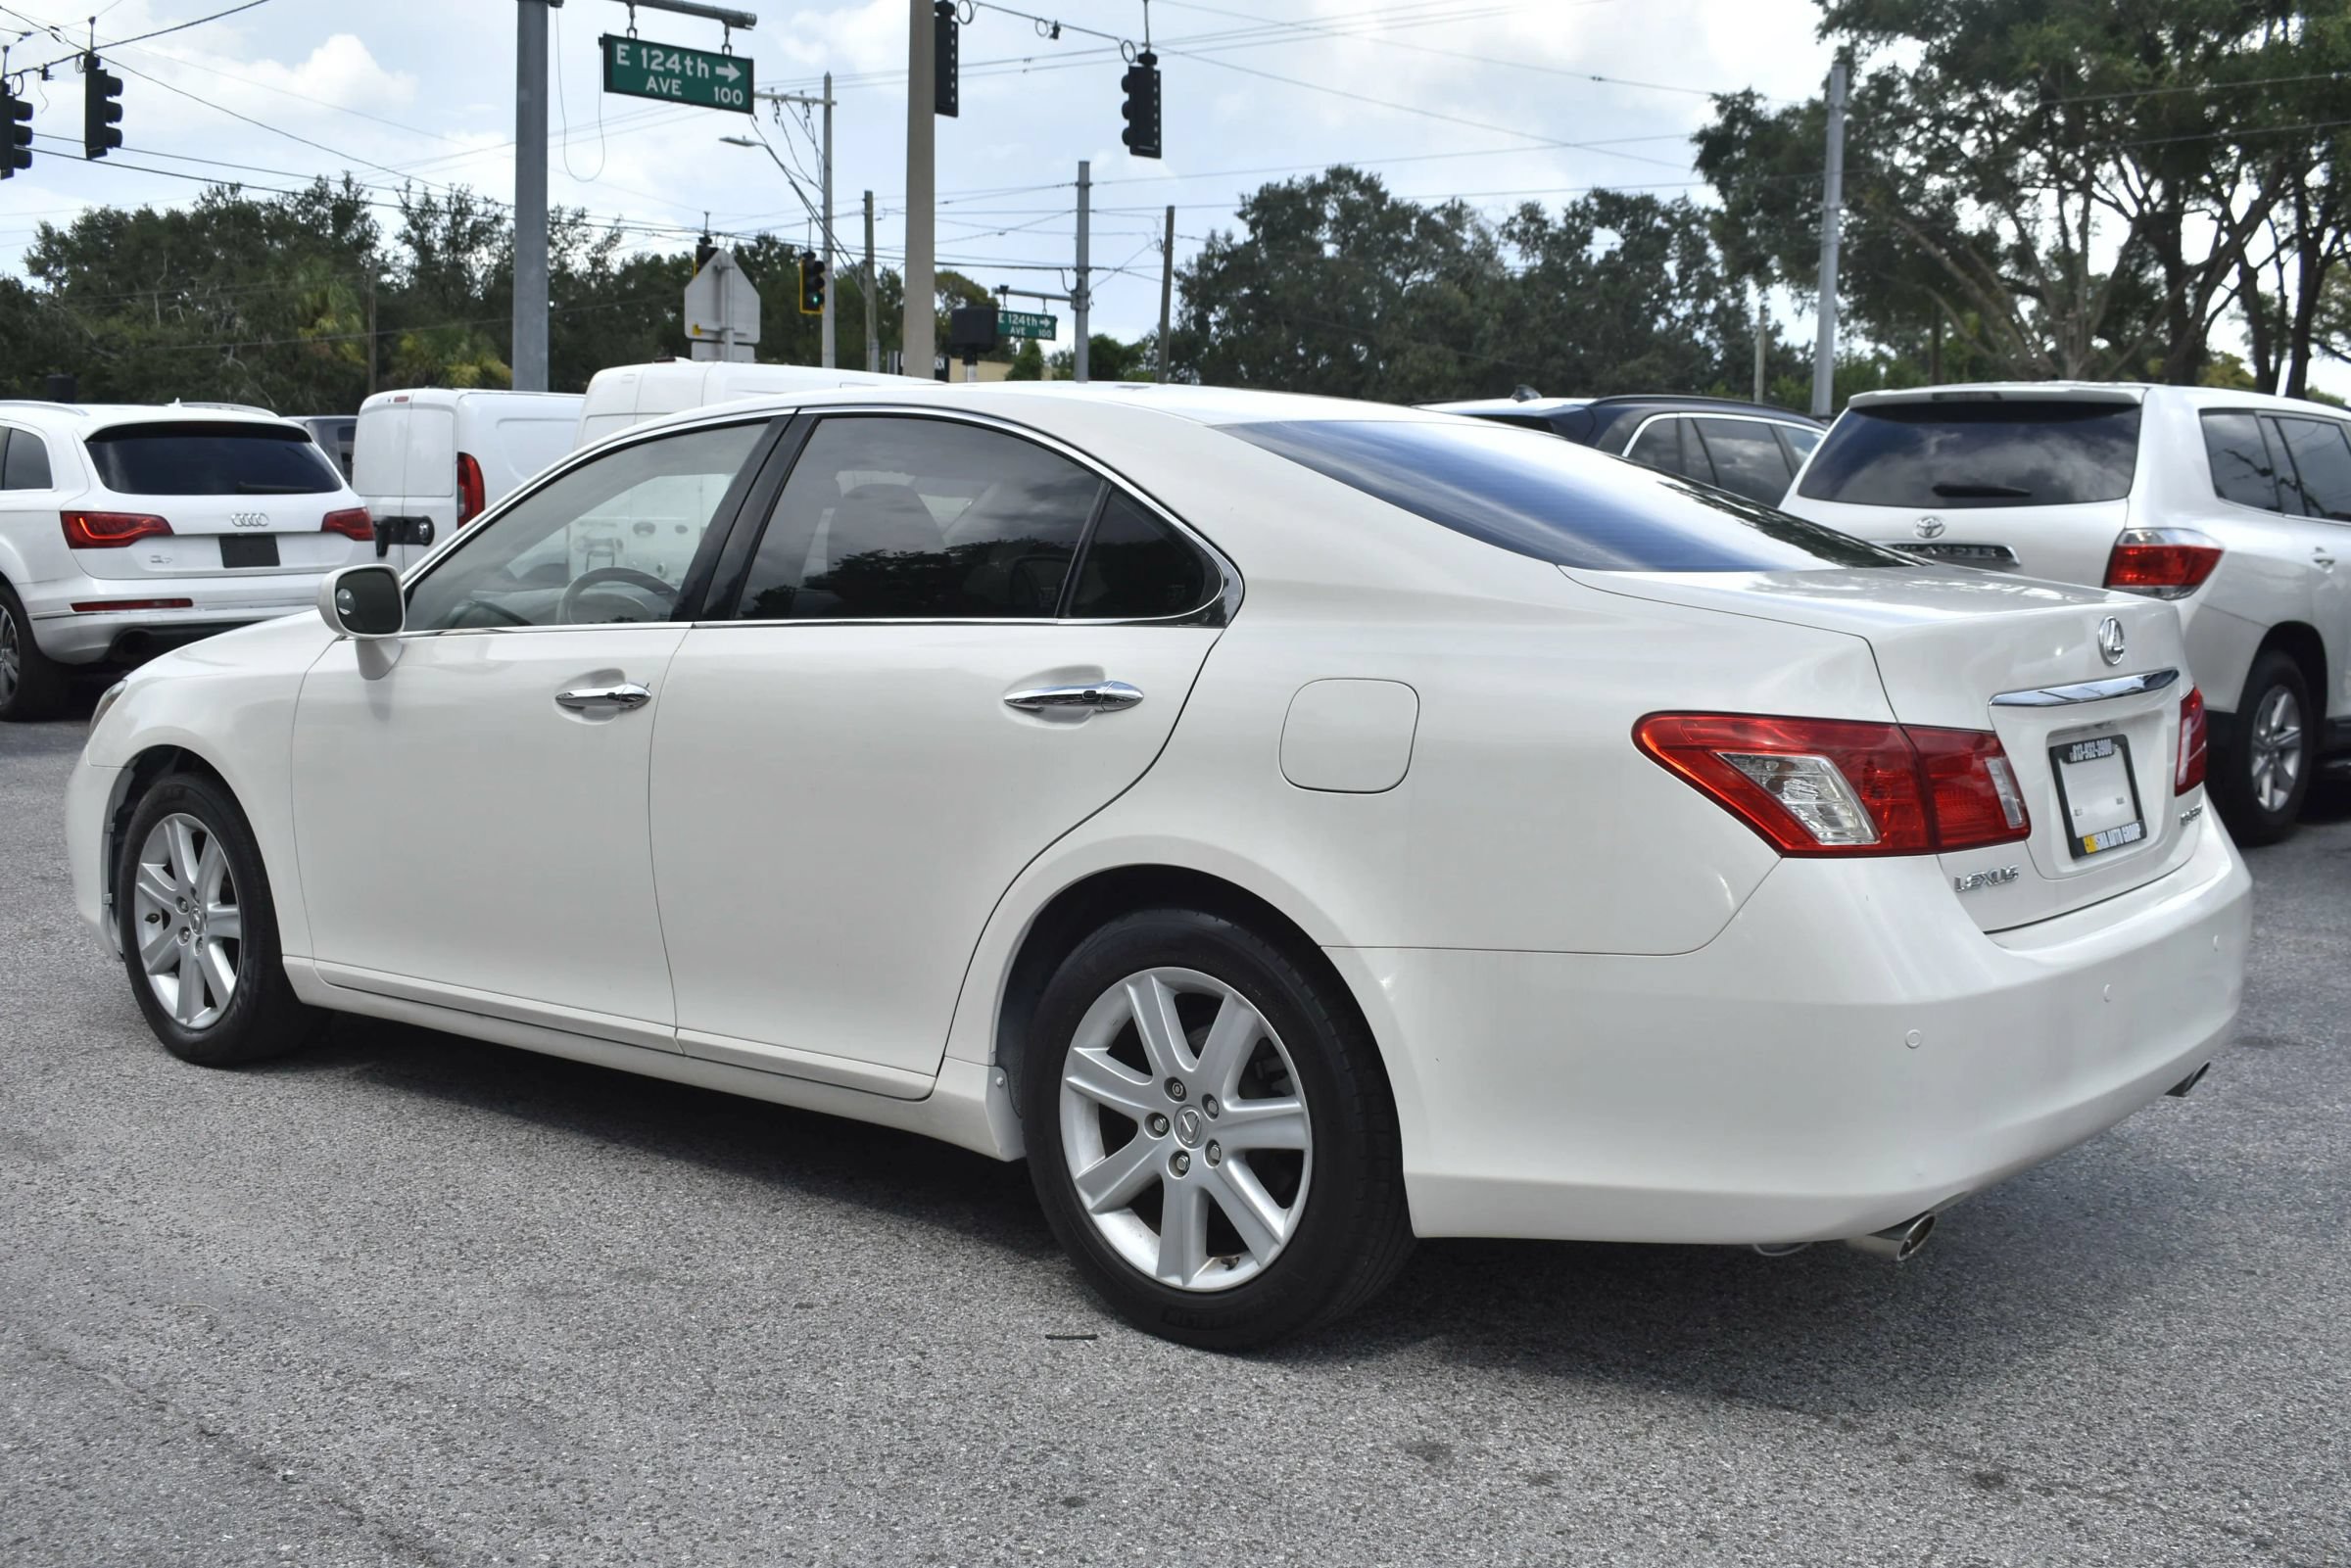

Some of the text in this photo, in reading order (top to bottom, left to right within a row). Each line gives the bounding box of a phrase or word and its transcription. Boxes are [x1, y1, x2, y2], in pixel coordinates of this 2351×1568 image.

[616, 43, 709, 78] E 124th
[646, 75, 744, 106] AVE 100
[997, 314, 1038, 327] E 124th
[1010, 327, 1026, 336] AVE
[1953, 864, 2019, 892] LEXUS
